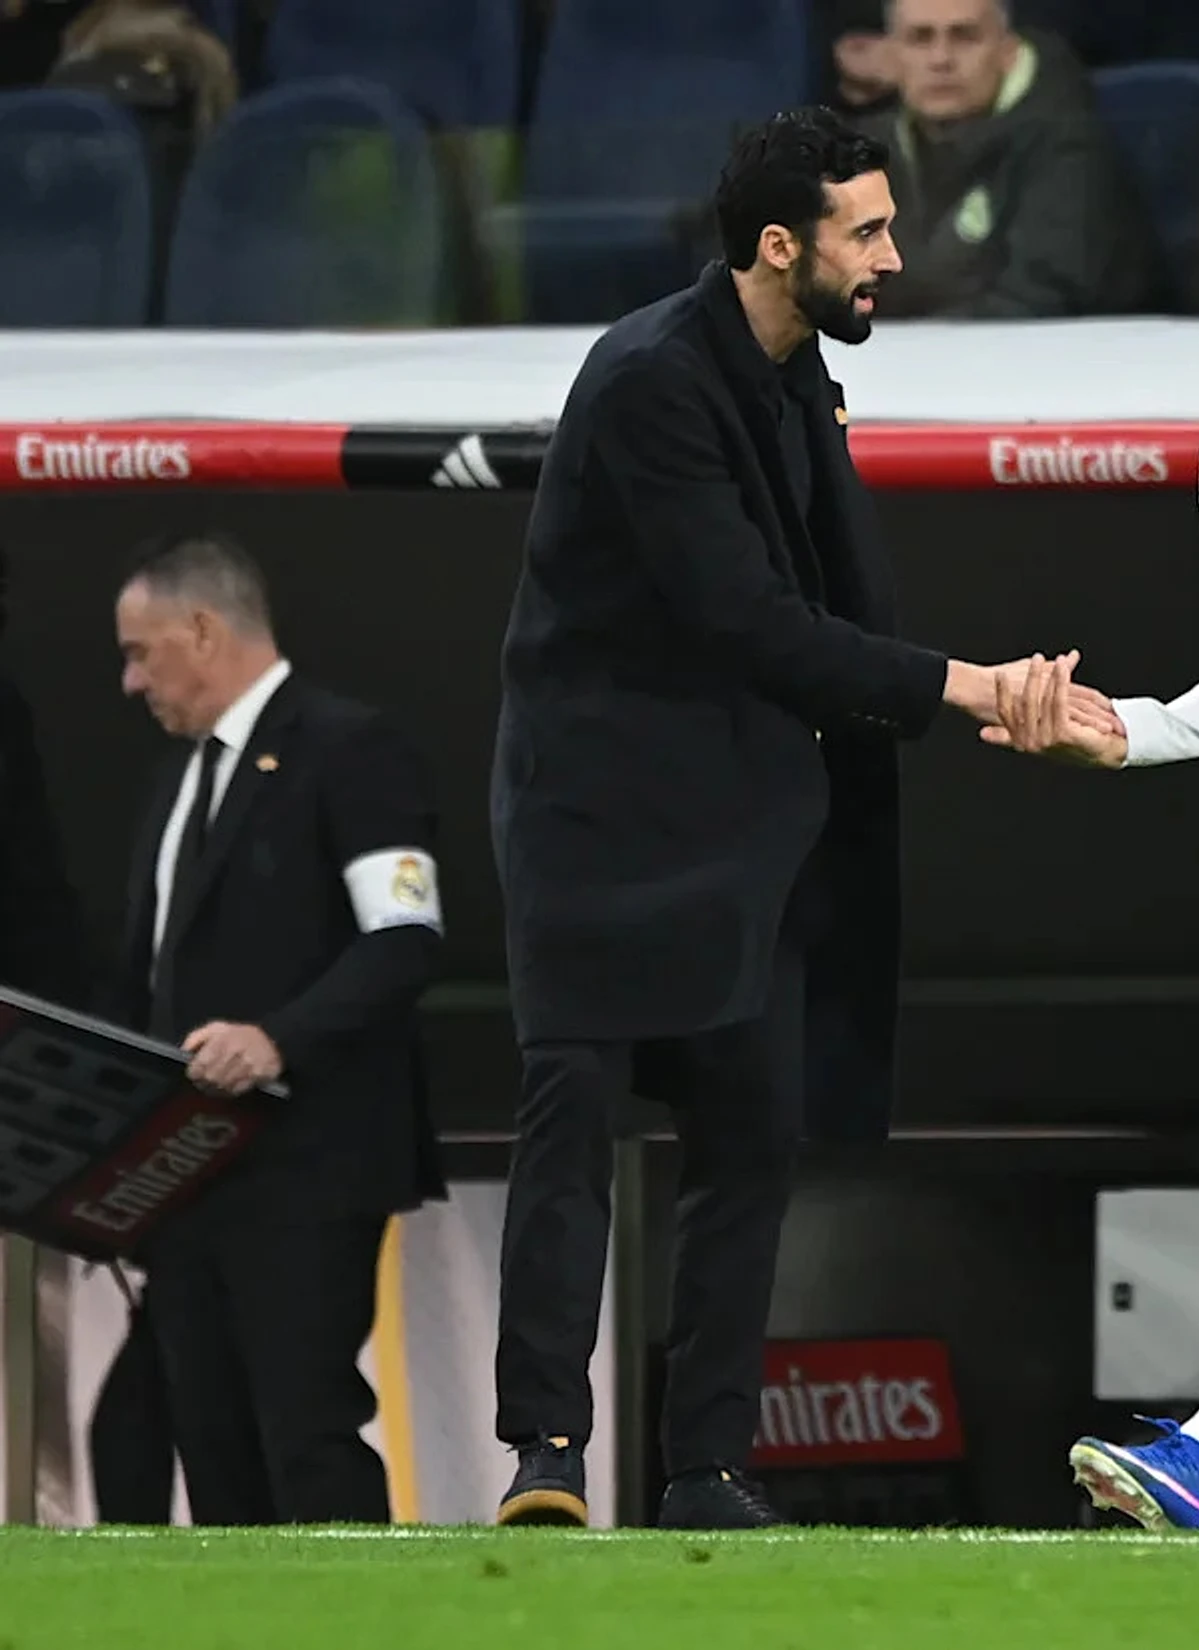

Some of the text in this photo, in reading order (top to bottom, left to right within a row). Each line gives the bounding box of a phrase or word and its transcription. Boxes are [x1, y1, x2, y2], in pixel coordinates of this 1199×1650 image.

[17, 434, 191, 480] Emirates
[988, 436, 1168, 485] Emirates
[71, 1113, 239, 1232] Emirates
[752, 1363, 943, 1447] mirates
